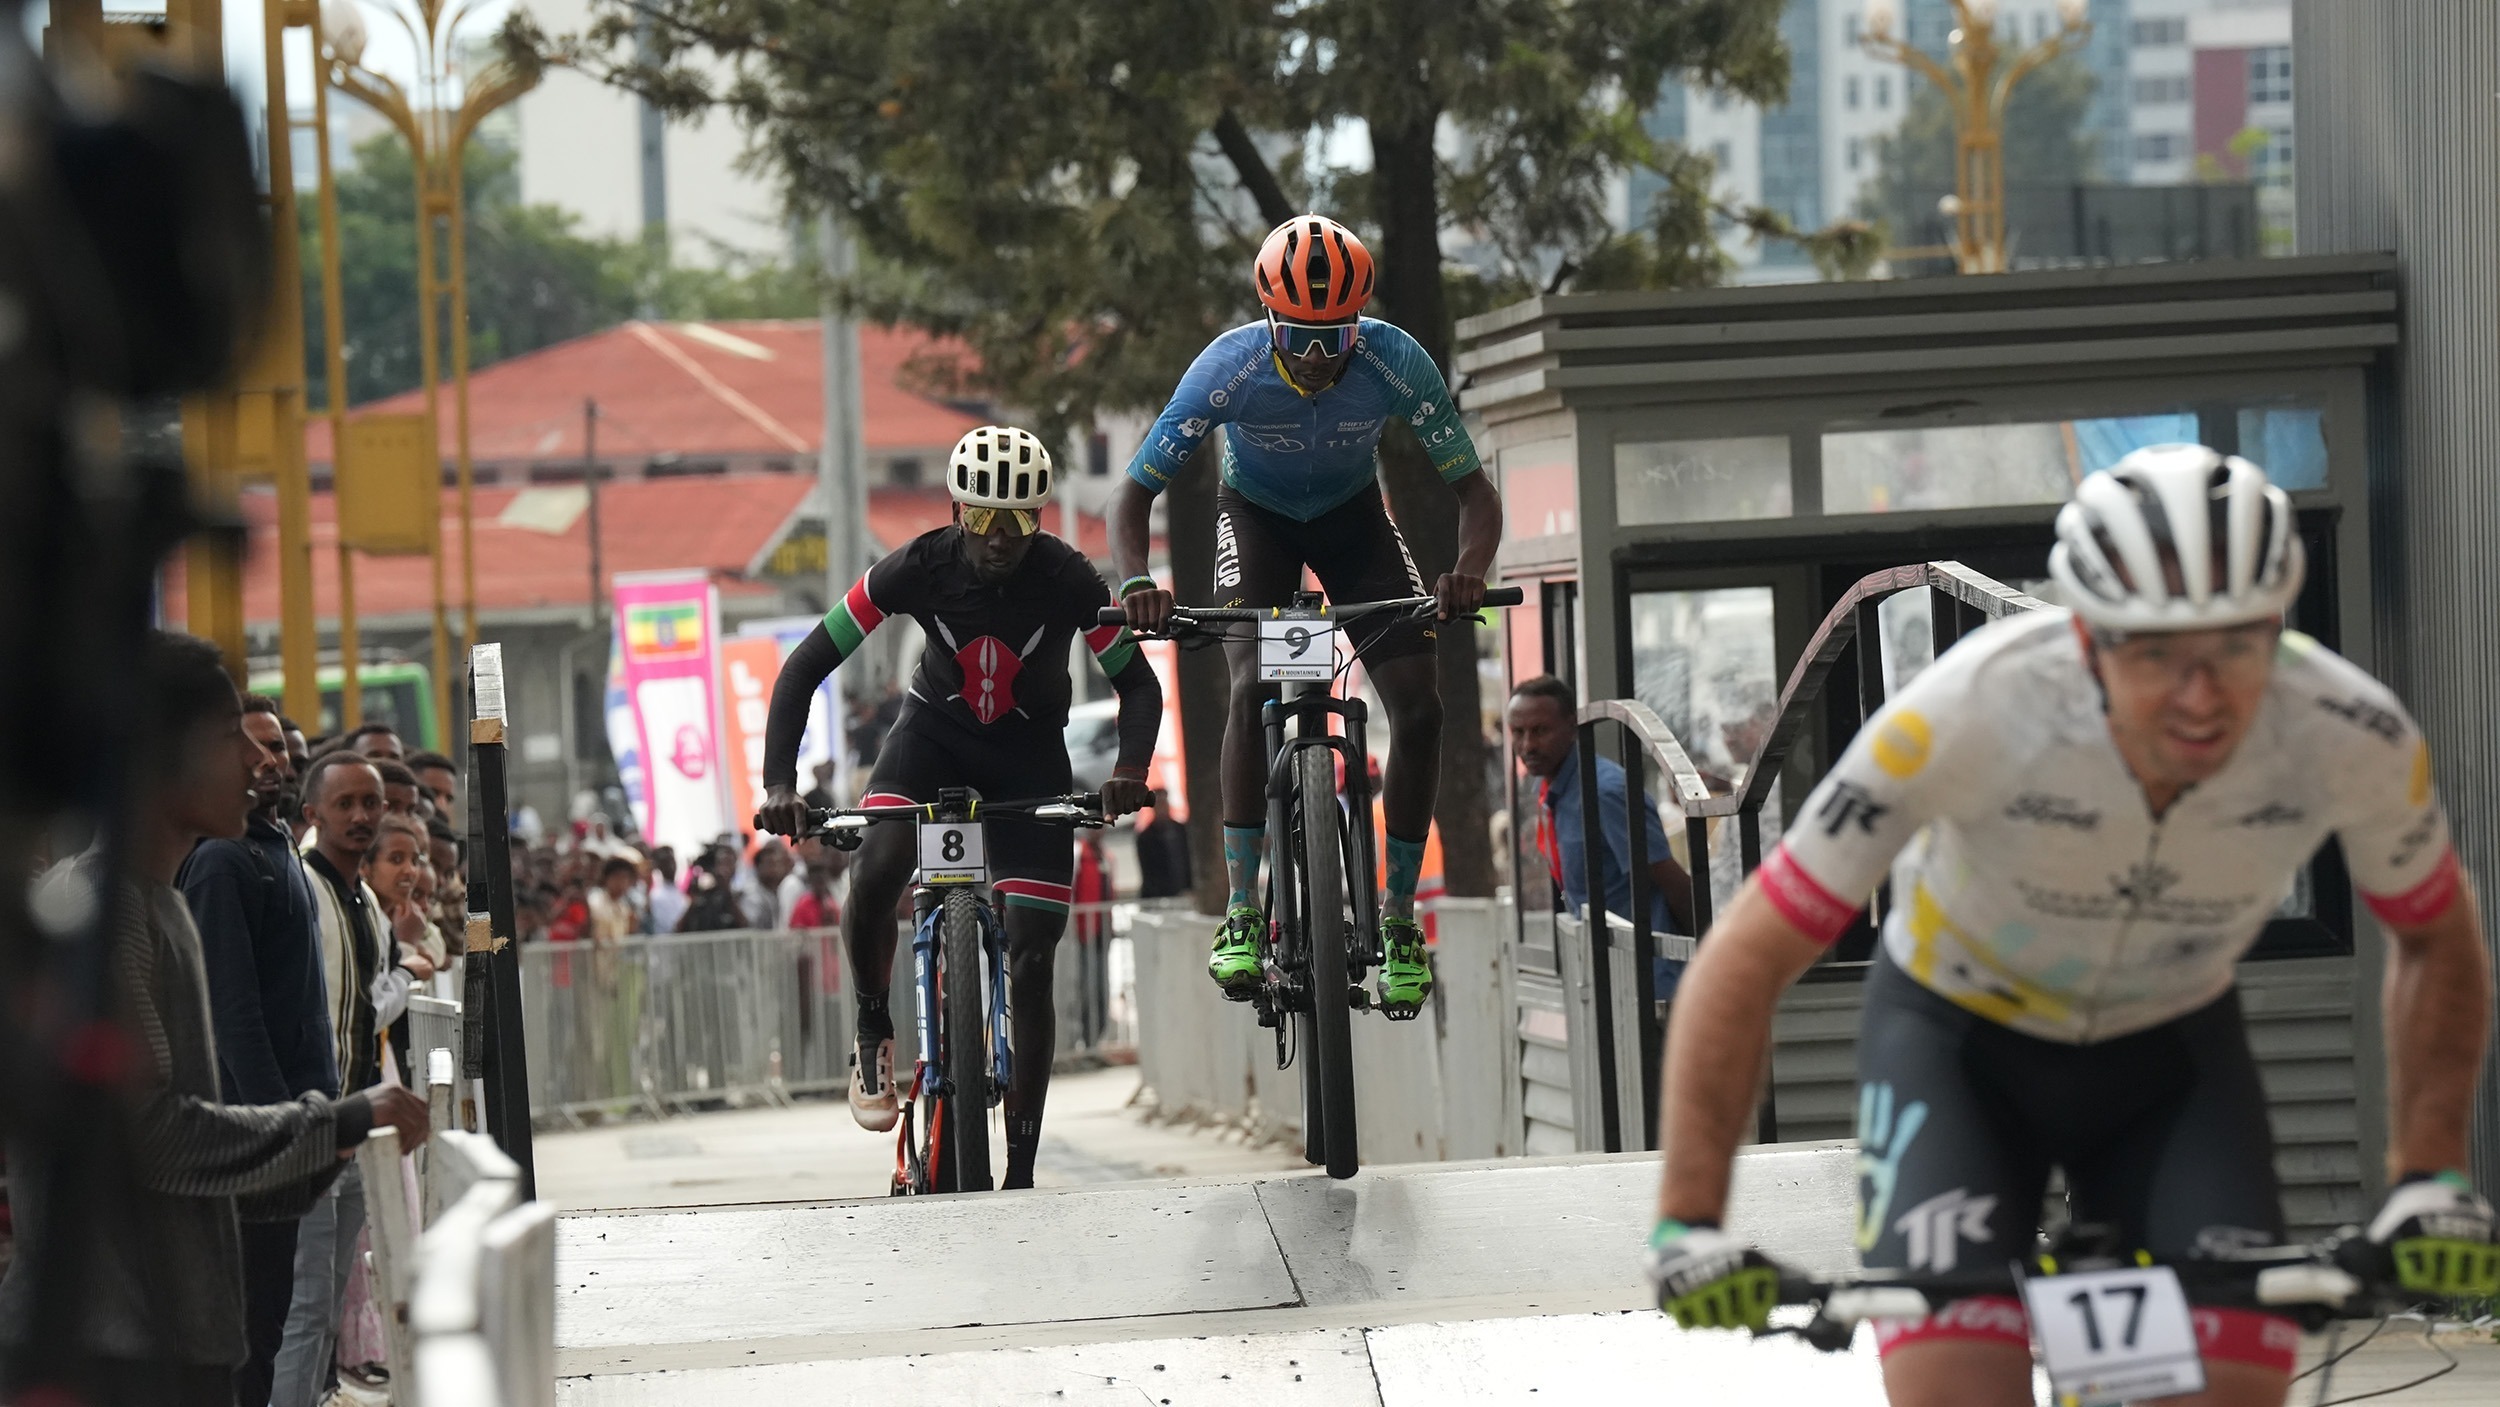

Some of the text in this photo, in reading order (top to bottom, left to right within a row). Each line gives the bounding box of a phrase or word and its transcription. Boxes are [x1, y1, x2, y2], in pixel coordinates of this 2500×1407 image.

[1365, 350, 1414, 399] enerquinn
[1284, 626, 1312, 660] 9
[941, 829, 965, 863] 8
[2069, 1284, 2148, 1352] 17
